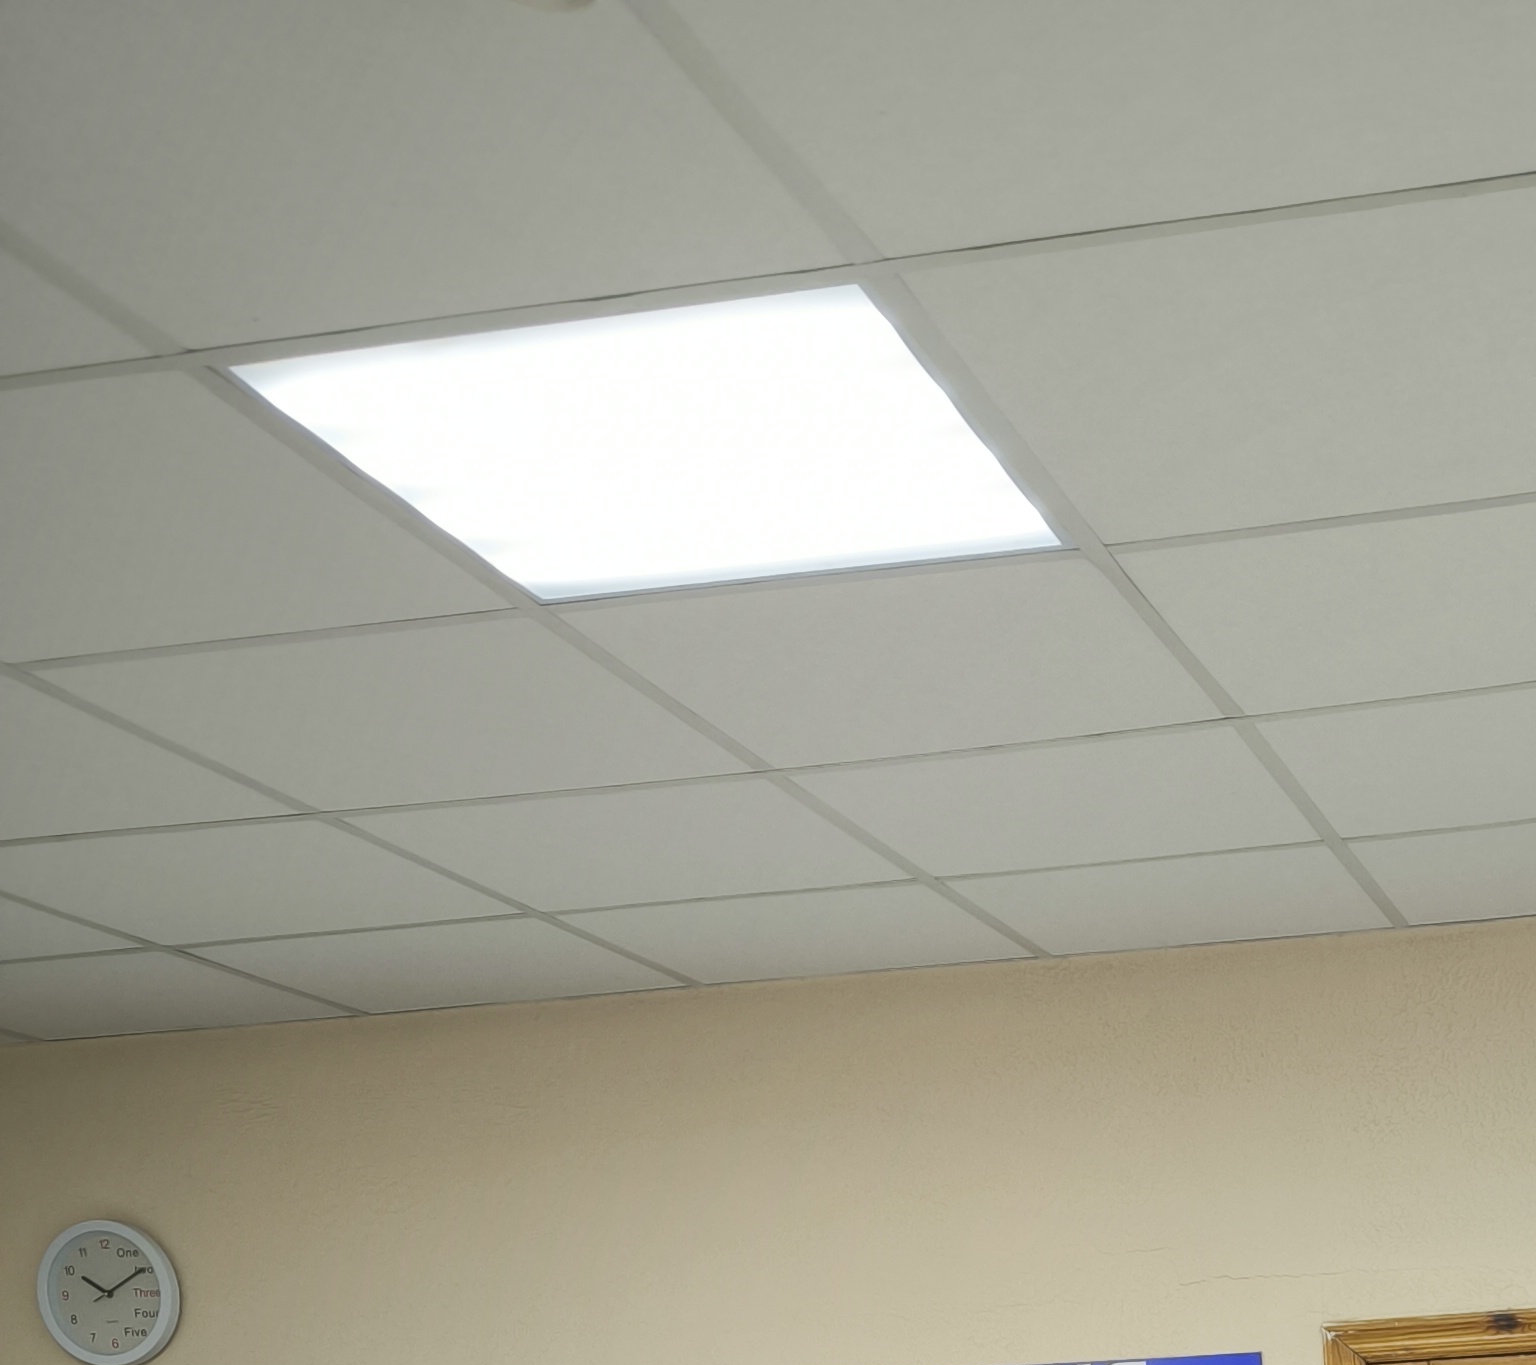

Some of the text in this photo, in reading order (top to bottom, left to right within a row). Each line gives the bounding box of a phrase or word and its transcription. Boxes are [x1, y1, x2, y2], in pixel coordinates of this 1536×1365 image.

[99, 1239, 110, 1249] 12
[79, 1248, 87, 1258] 11
[117, 1248, 139, 1258] One
[64, 1265, 75, 1276] 10
[62, 1291, 69, 1300] 9
[133, 1288, 161, 1298] Three
[71, 1314, 78, 1325] 8
[124, 1327, 147, 1337] Five
[90, 1333, 96, 1343] 7
[112, 1338, 119, 1348] 6
